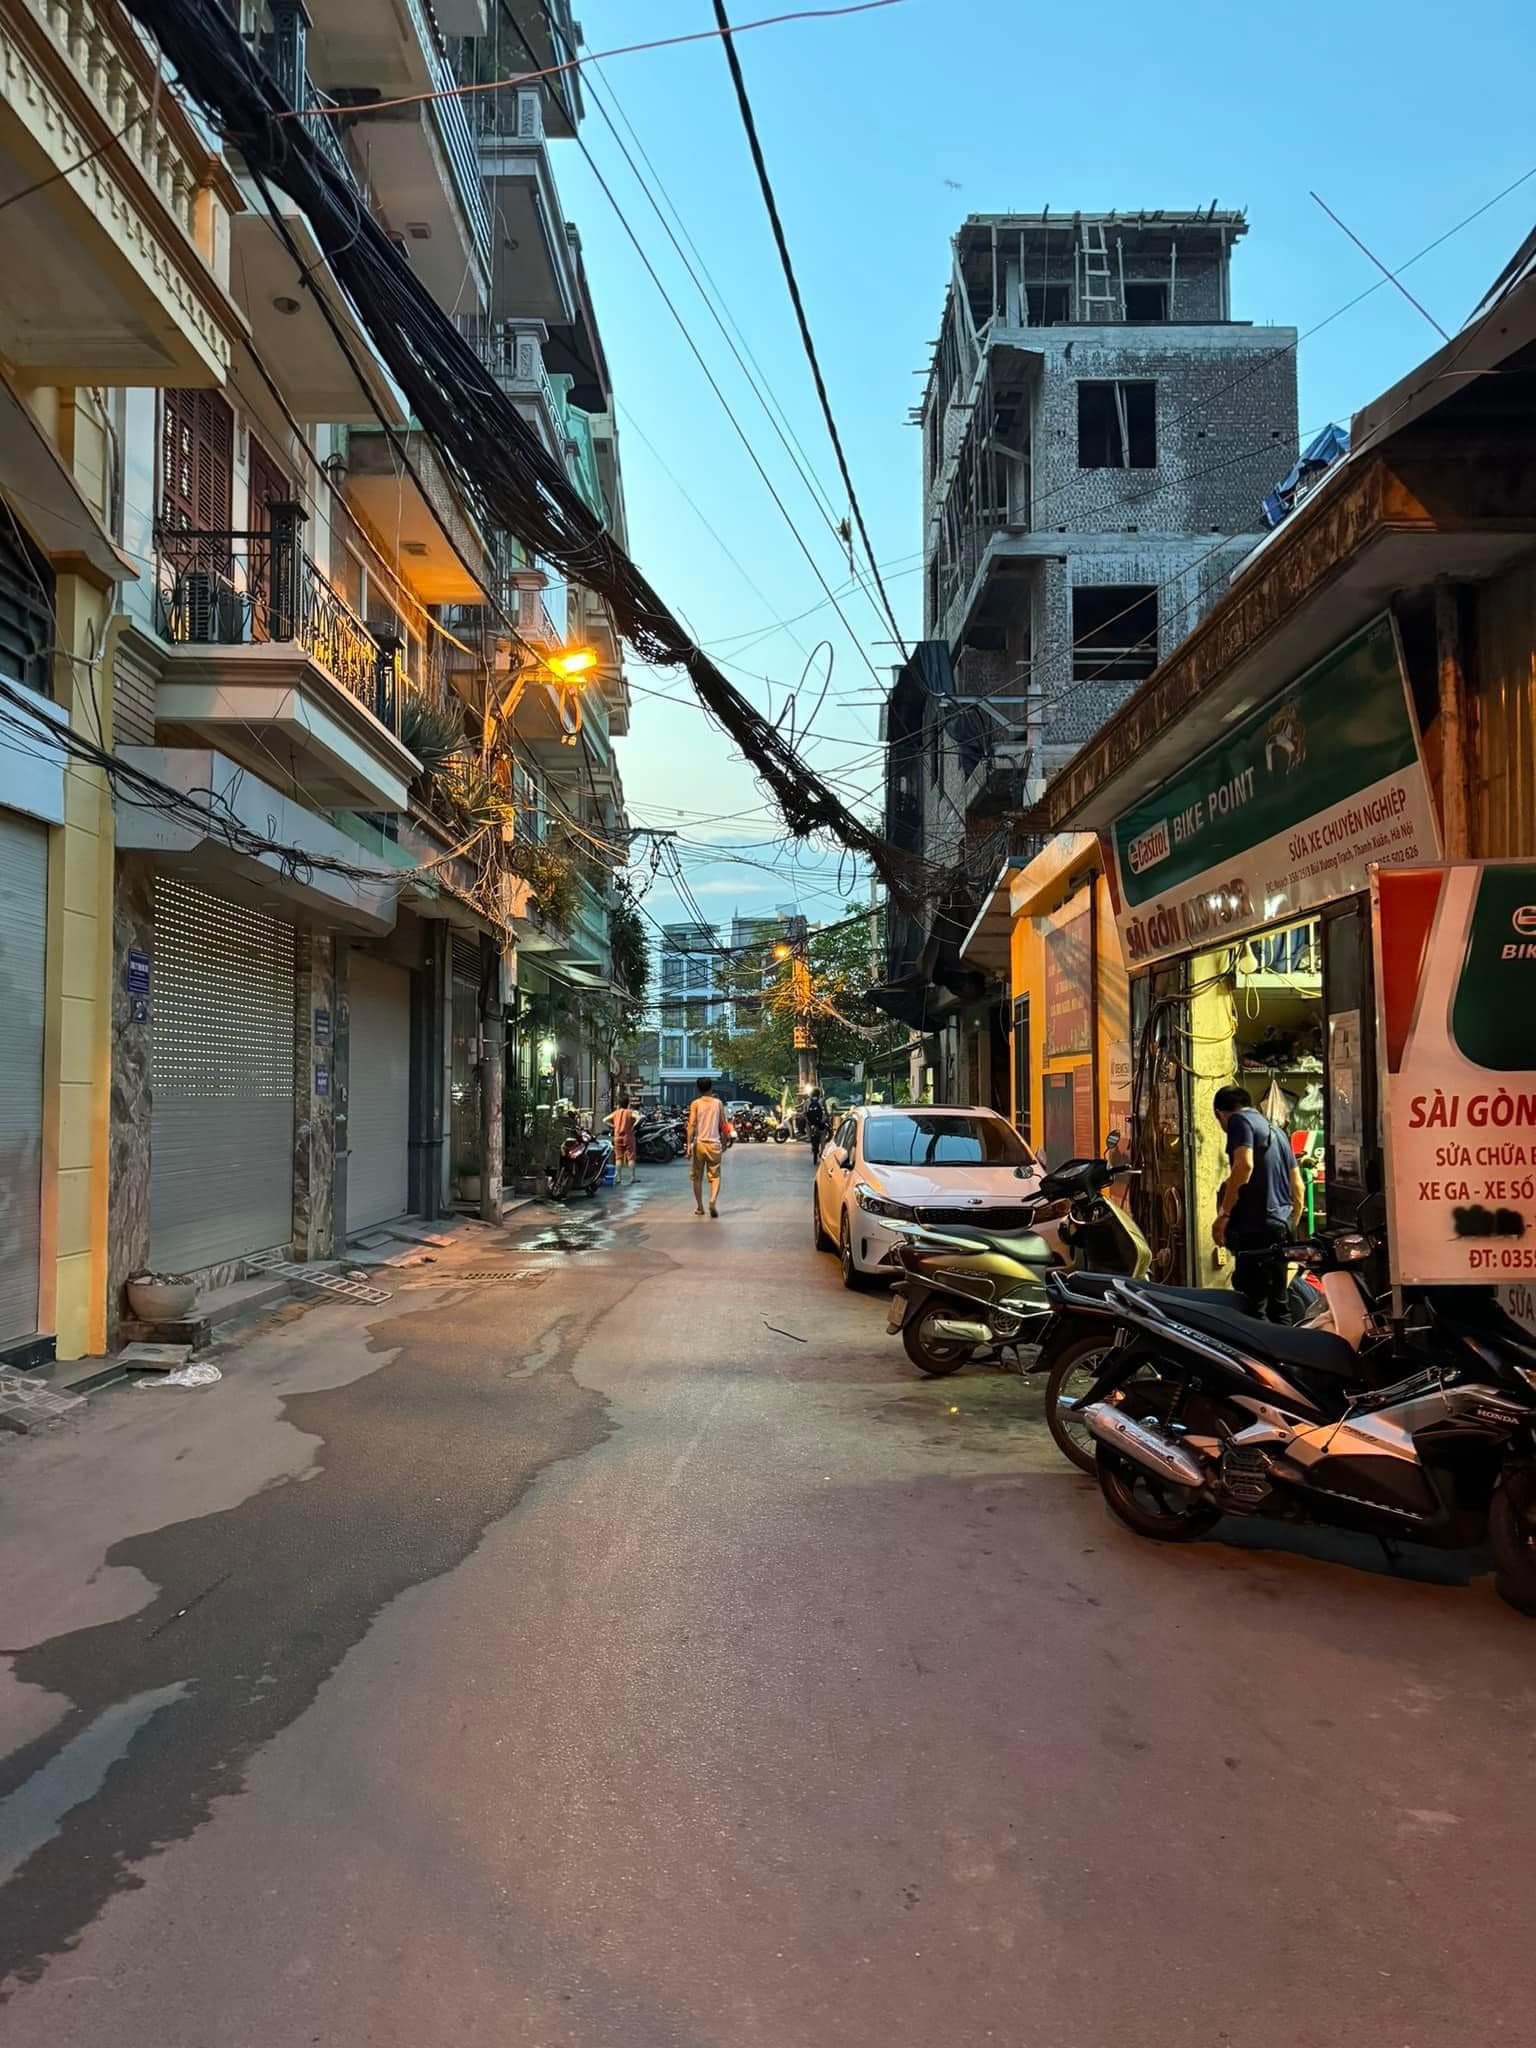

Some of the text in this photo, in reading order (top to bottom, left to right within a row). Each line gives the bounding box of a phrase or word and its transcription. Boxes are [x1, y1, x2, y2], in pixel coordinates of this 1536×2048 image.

[1136, 766, 1255, 867] Castrol BIKE POINT
[1308, 829, 1323, 854] XE
[1322, 809, 1363, 847] CHUYÊN
[1363, 787, 1406, 828] NGHIỆP
[1126, 916, 1149, 959] SÀI
[1147, 903, 1181, 949] GÒN
[1408, 1087, 1536, 1129] SÀI GÒN
[1435, 1141, 1473, 1167] SỬA
[1475, 1141, 1527, 1167] CHỮA
[1418, 1181, 1441, 1201] XE
[1444, 1181, 1470, 1201] GA
[1484, 1180, 1507, 1201] XE
[1510, 1173, 1535, 1201] SỐ
[1469, 1248, 1536, 1269] ĐT: 035
[1476, 1408, 1521, 1425] HONDA
